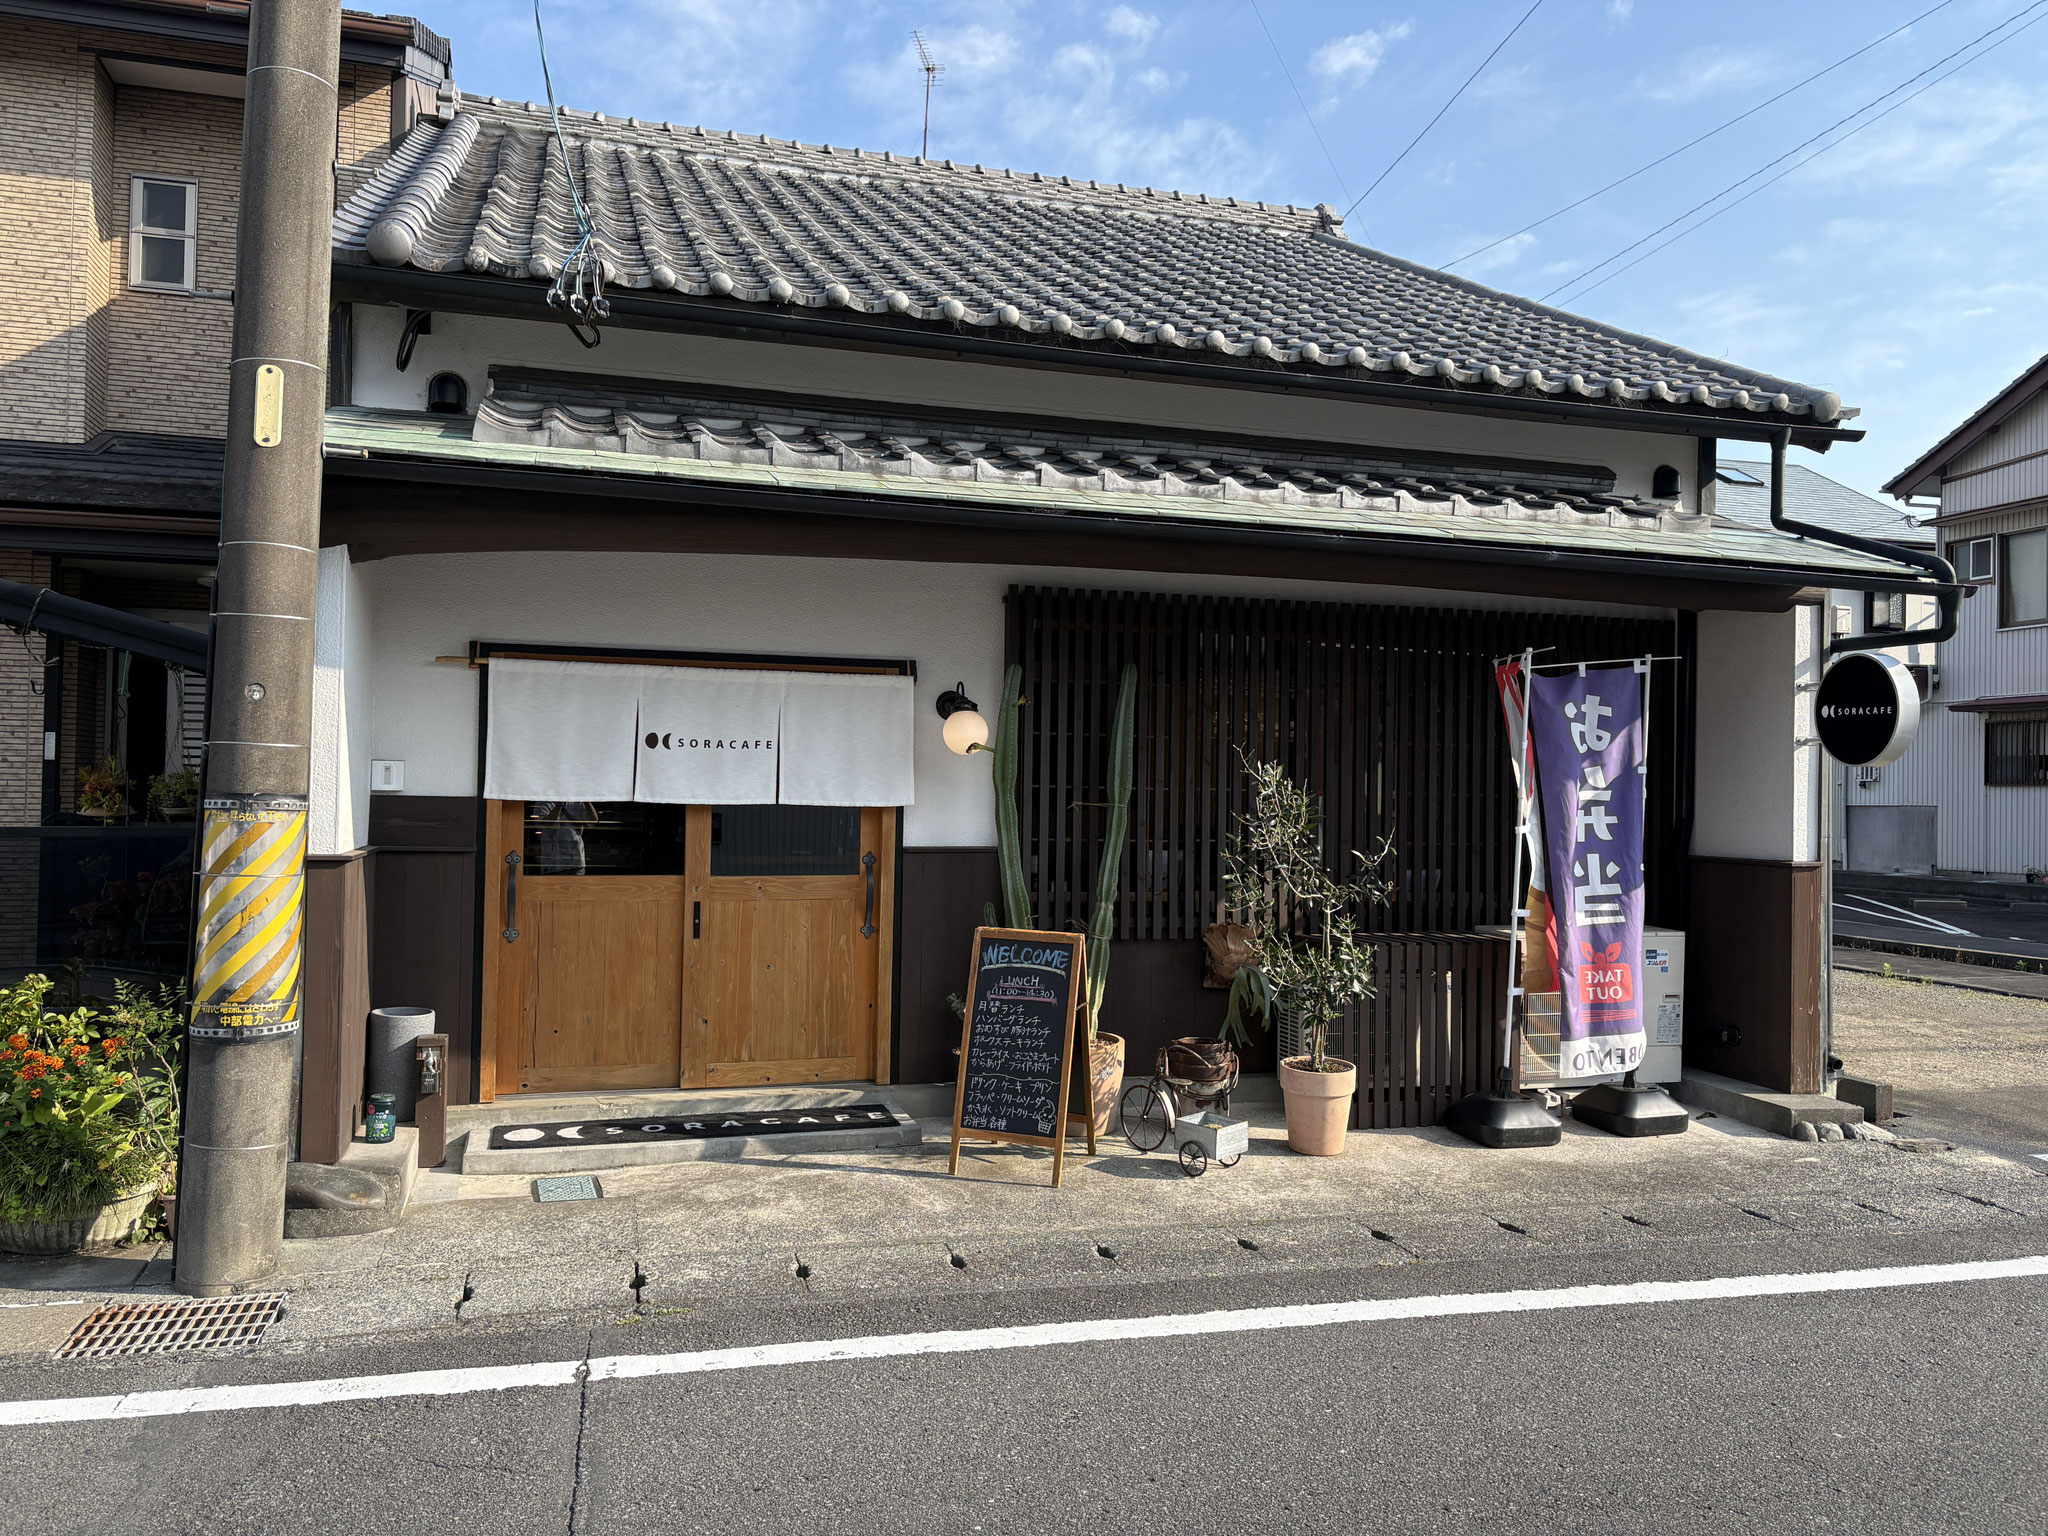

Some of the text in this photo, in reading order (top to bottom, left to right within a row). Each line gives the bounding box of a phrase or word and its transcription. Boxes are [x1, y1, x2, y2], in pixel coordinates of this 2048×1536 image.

[1837, 706, 1892, 716] SORACAFE
[677, 738, 773, 750] SORACAFE
[983, 943, 1070, 969] WELCOME
[1000, 975, 1040, 987] LUNCH
[979, 1000, 1025, 1015] 月替ランチ
[975, 1014, 1041, 1027] ハンバーグランチ
[973, 1035, 1047, 1050] ポークステーキランチ
[605, 1111, 887, 1136] SORACAFE
[963, 1115, 1008, 1131] お弁当各種
